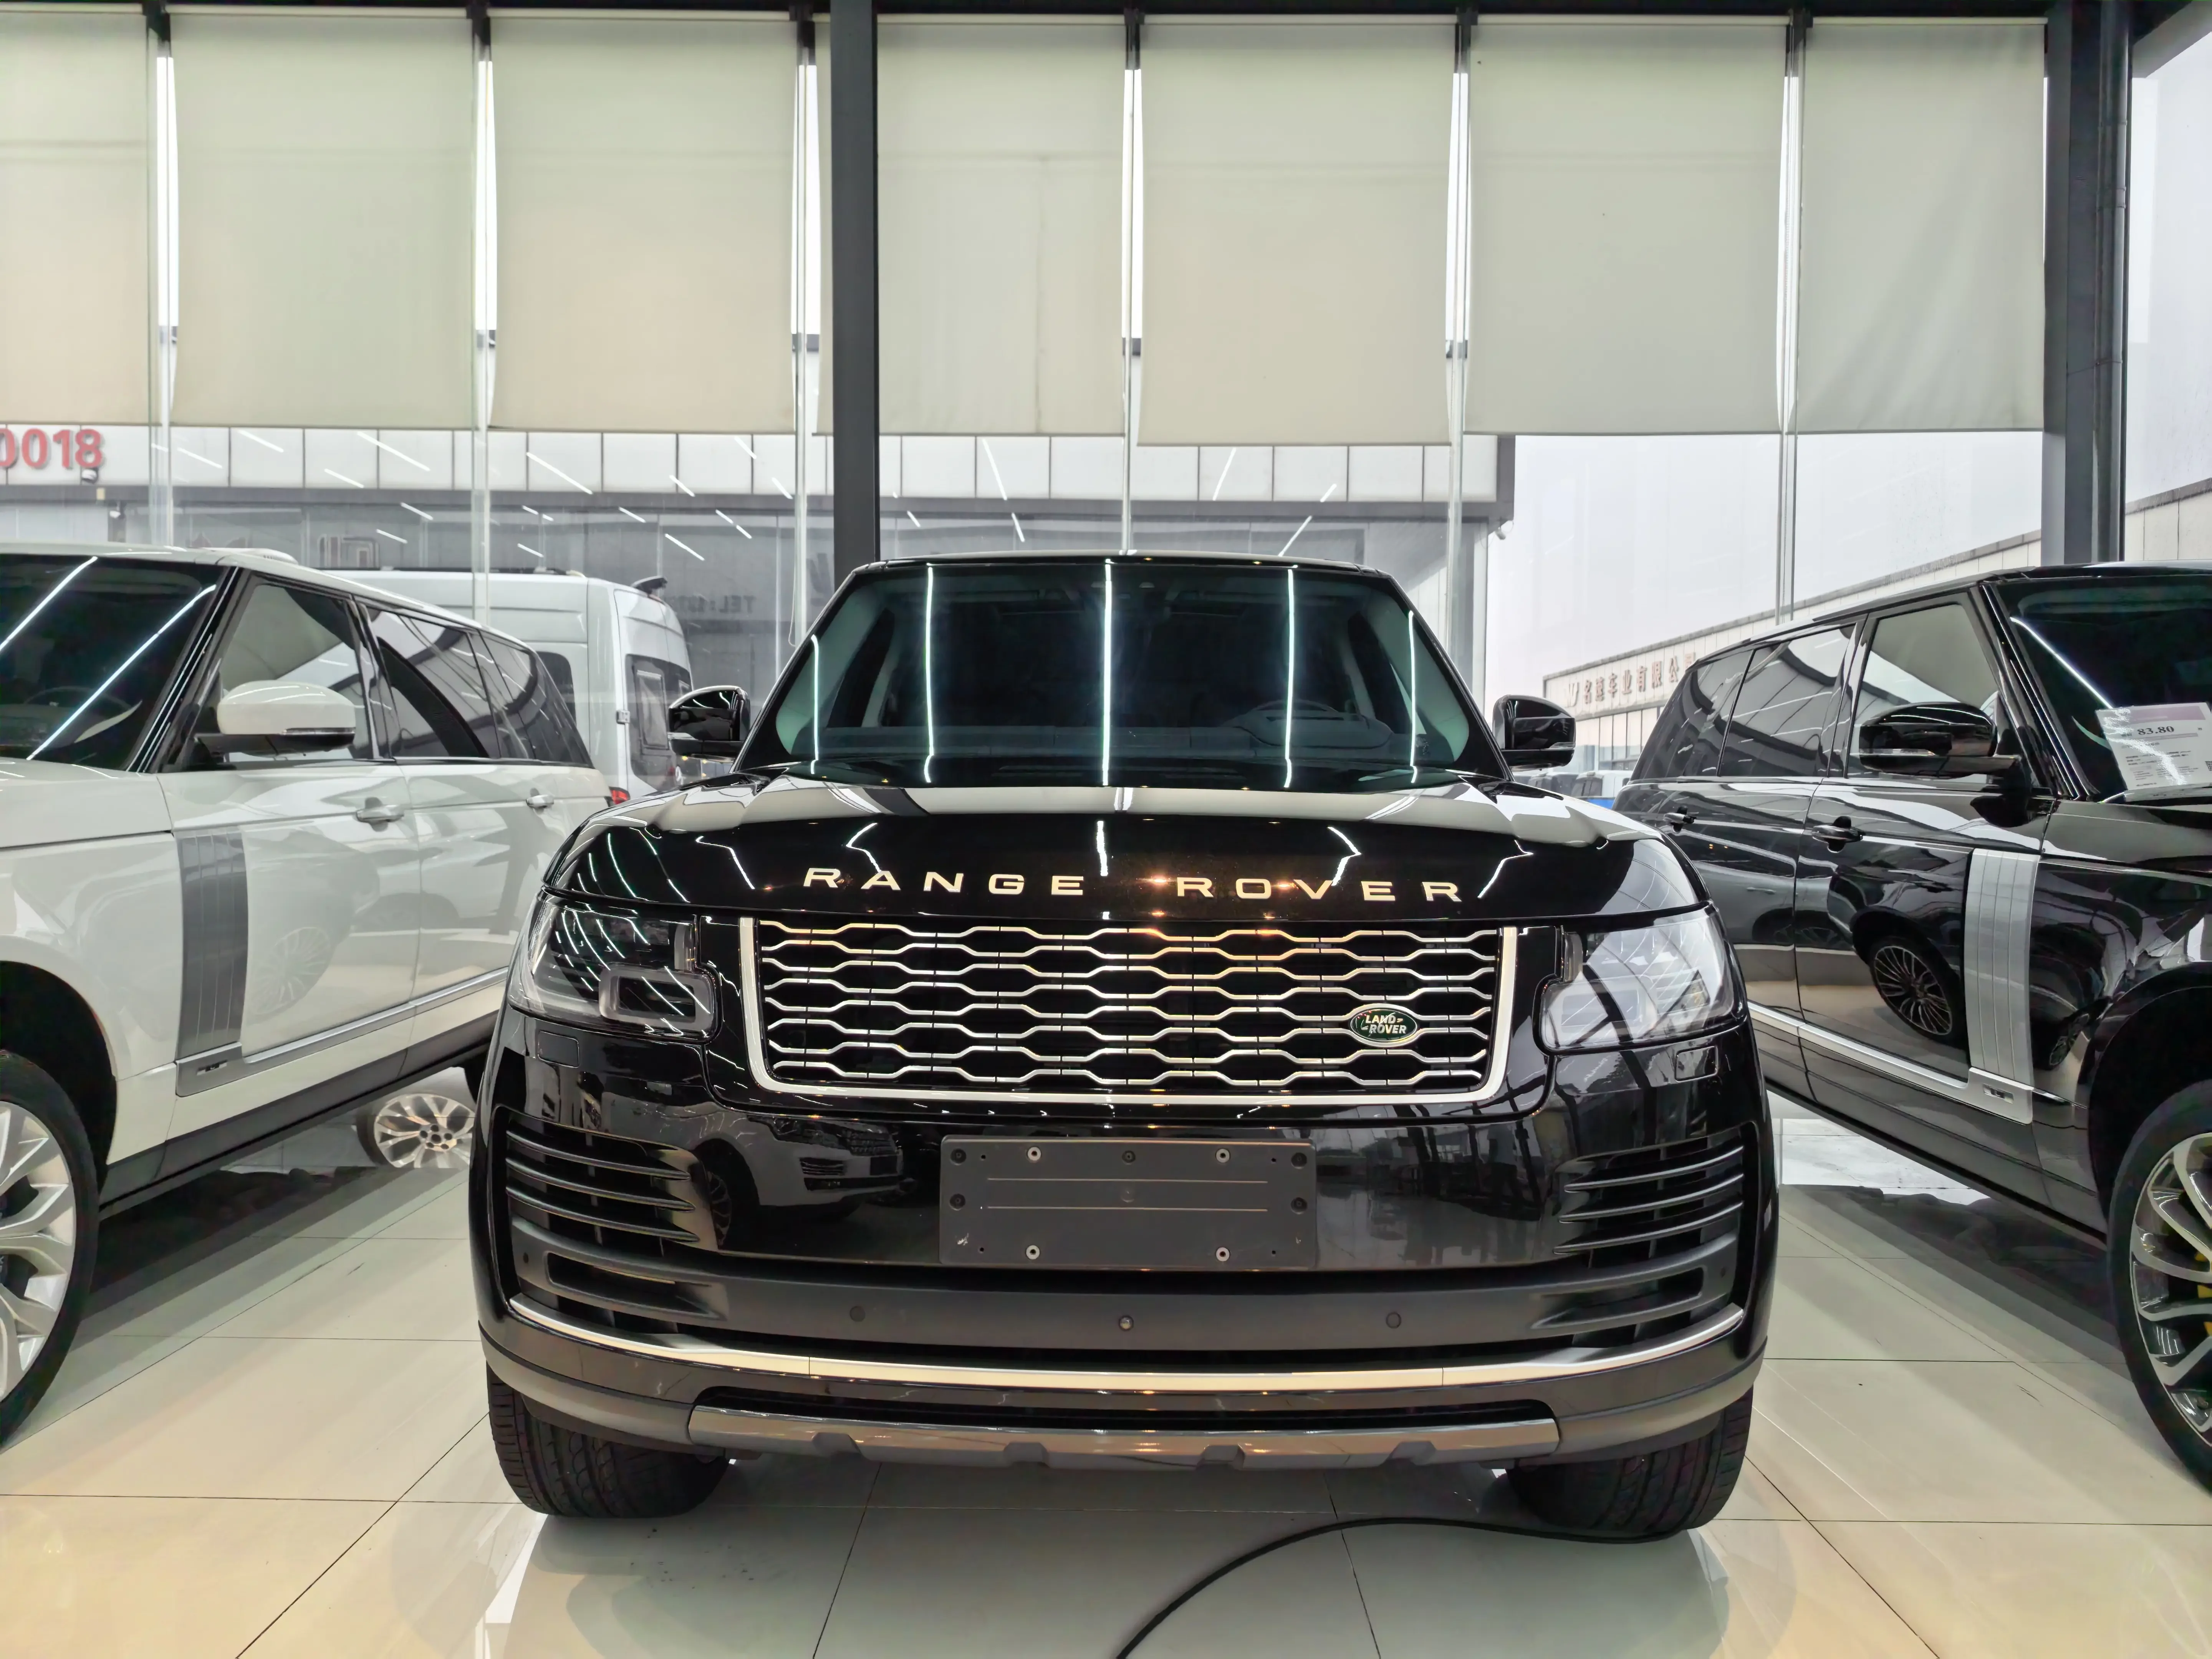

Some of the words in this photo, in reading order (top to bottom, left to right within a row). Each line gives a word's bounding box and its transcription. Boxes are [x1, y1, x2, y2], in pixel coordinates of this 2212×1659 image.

[0, 428, 103, 469] 0018
[2137, 726, 2174, 735] 83.80
[803, 868, 1084, 896] RANGE
[1177, 877, 1462, 902] ROVER
[1365, 1015, 1396, 1024] LAND
[1369, 1024, 1407, 1034] ROVER
